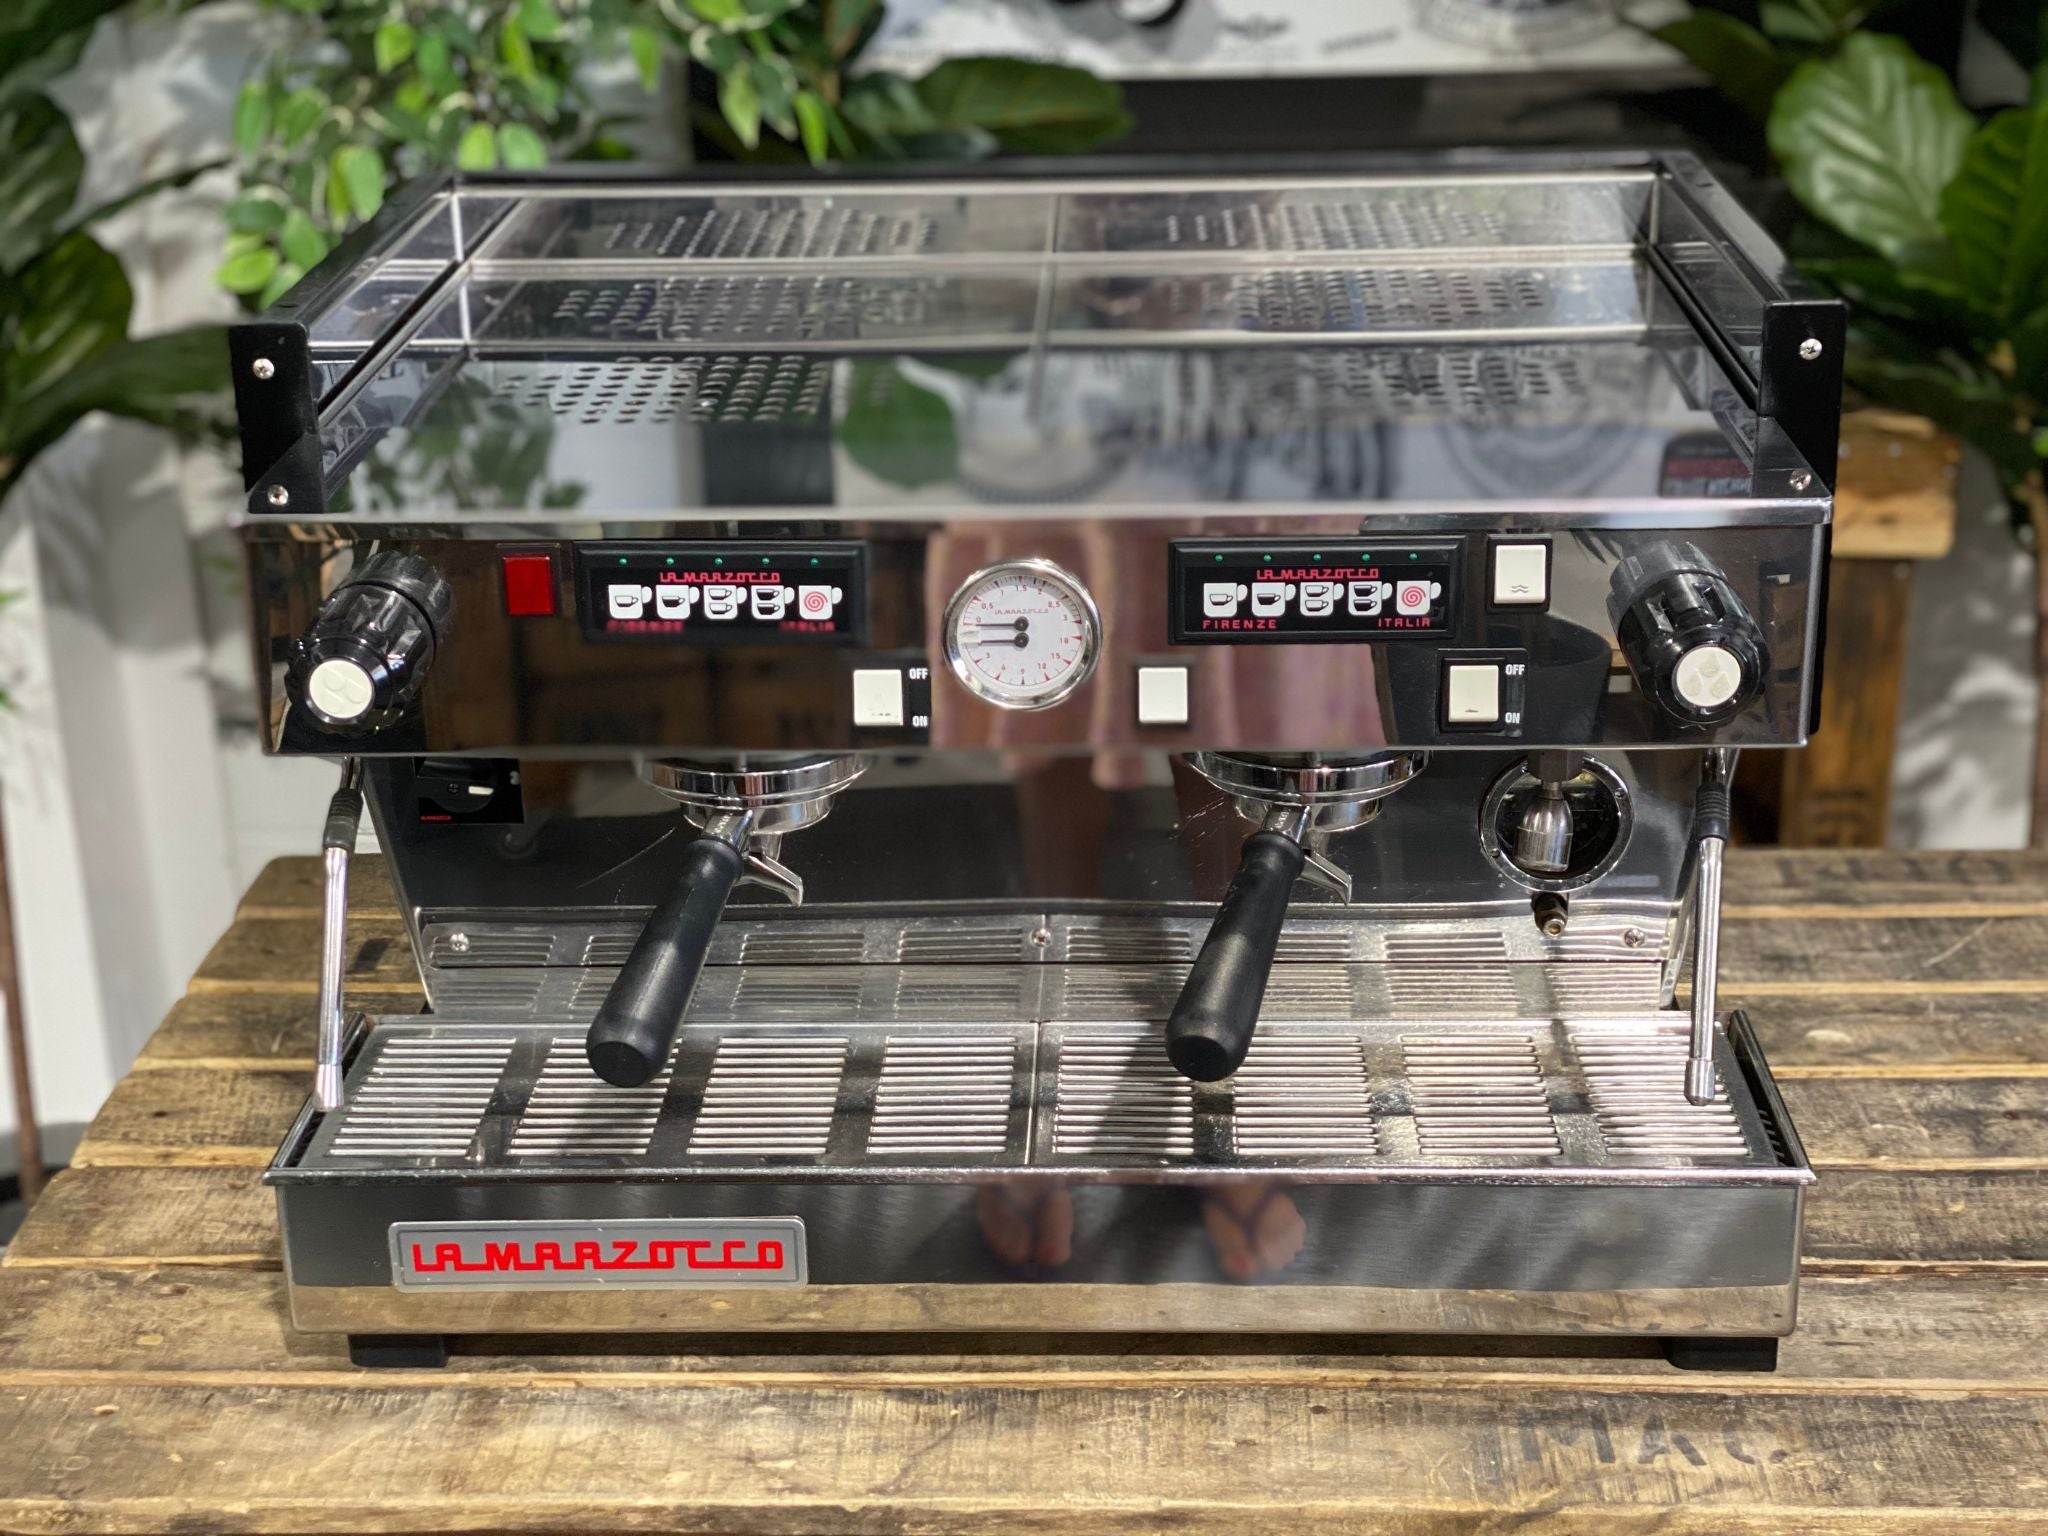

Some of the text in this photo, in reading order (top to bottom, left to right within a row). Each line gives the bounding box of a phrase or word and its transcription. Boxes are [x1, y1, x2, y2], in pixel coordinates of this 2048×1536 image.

[1202, 617, 1431, 629] FIRENZE ITALIA
[909, 668, 928, 679] OFF
[1505, 664, 1525, 675] OFF
[912, 716, 928, 727] ON
[1505, 712, 1520, 723] ON
[412, 1241, 783, 1272] LA MARZOCCO
